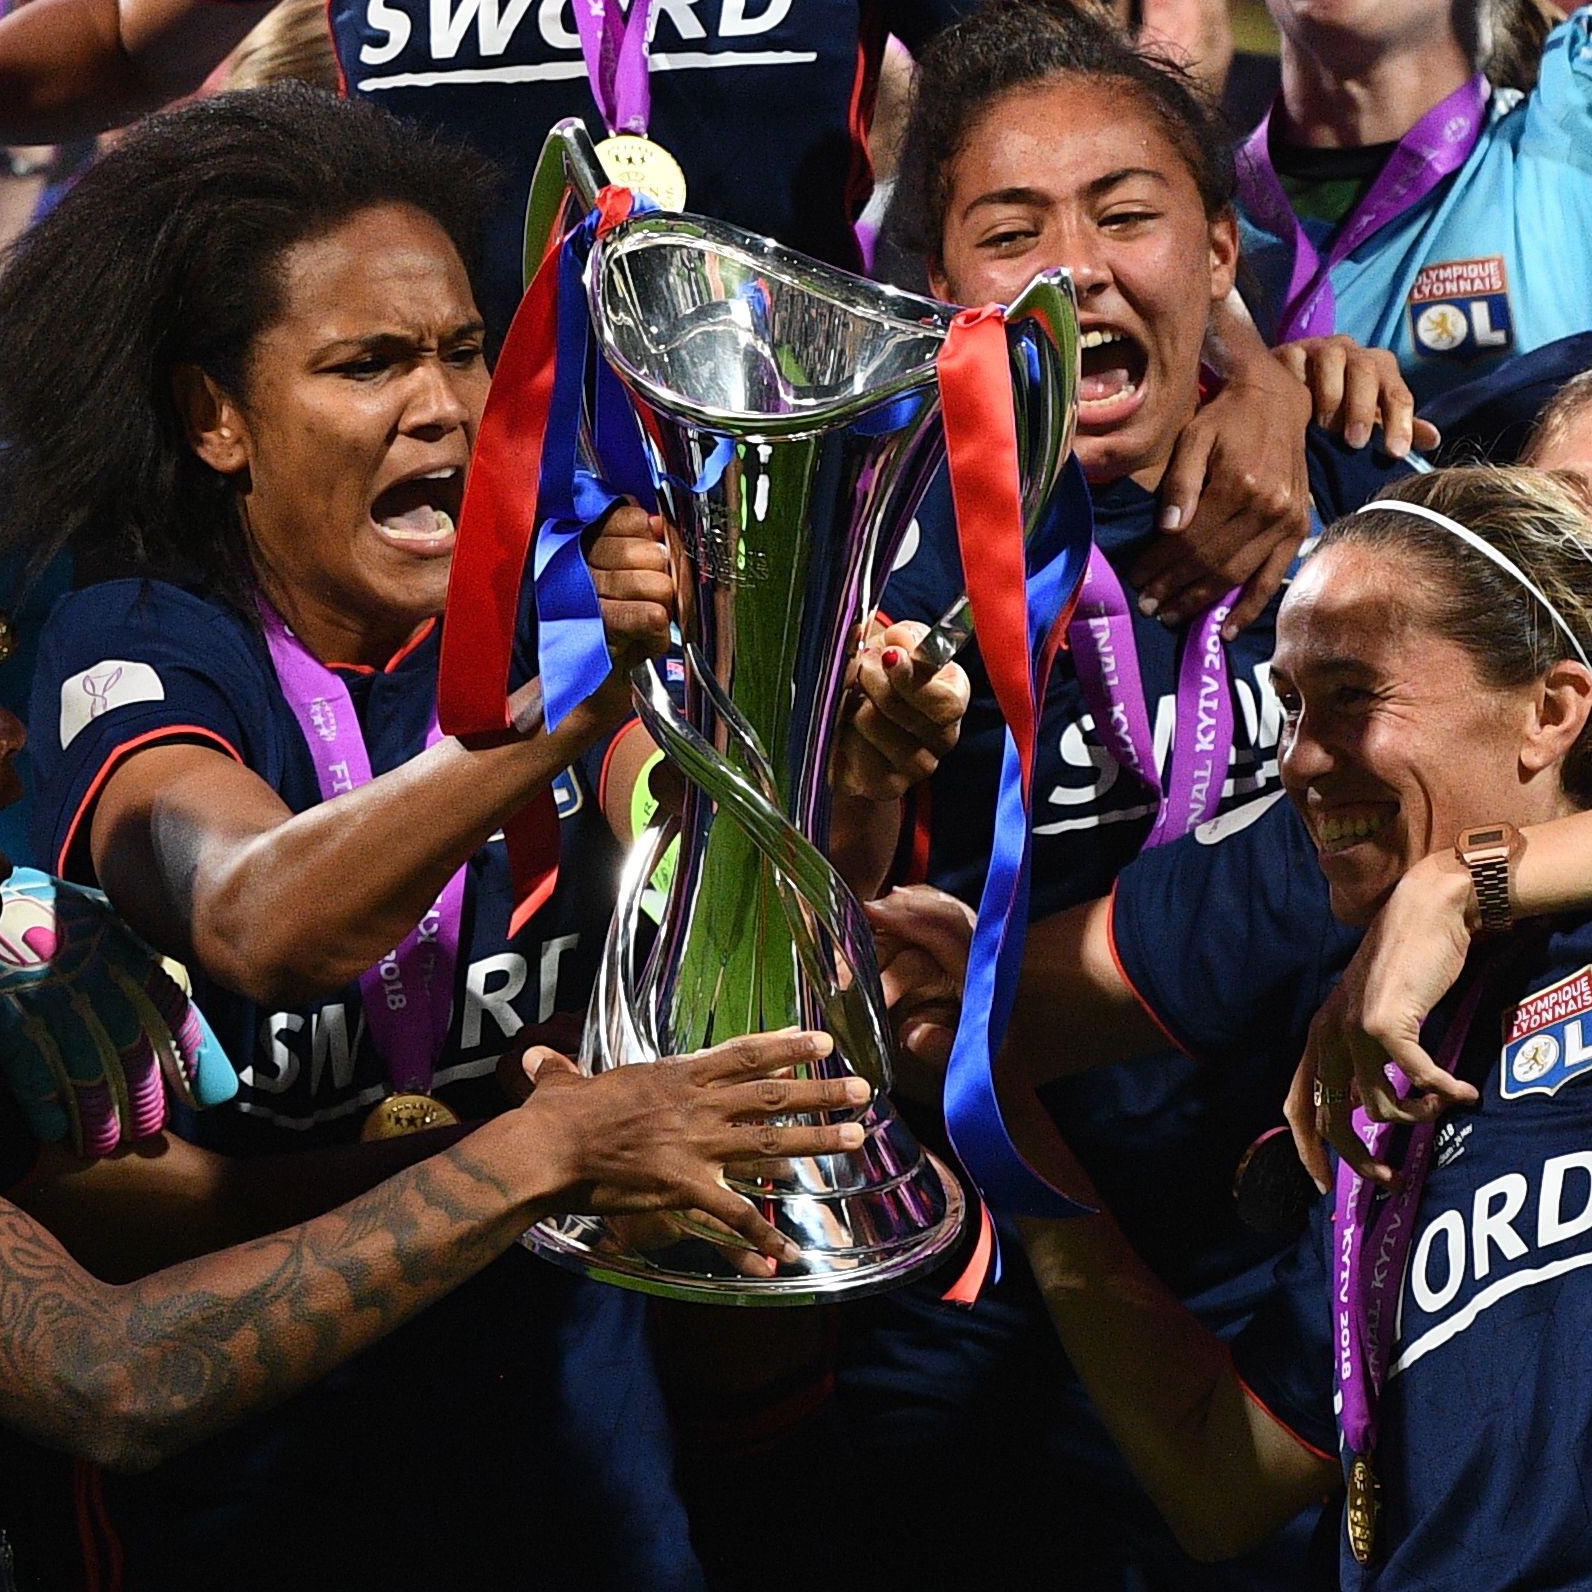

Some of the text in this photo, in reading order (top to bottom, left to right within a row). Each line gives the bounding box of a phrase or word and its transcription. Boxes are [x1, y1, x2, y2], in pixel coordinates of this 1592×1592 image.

[1413, 275, 1503, 300] LYONNAIS
[1417, 301, 1508, 352] OL
[1194, 674, 1221, 754] KYIV
[1512, 990, 1592, 1039] LYONNAIS
[1342, 1223, 1356, 1304] KYIV
[1370, 1213, 1402, 1290] KYIV
[1339, 1310, 1352, 1382] 2018
